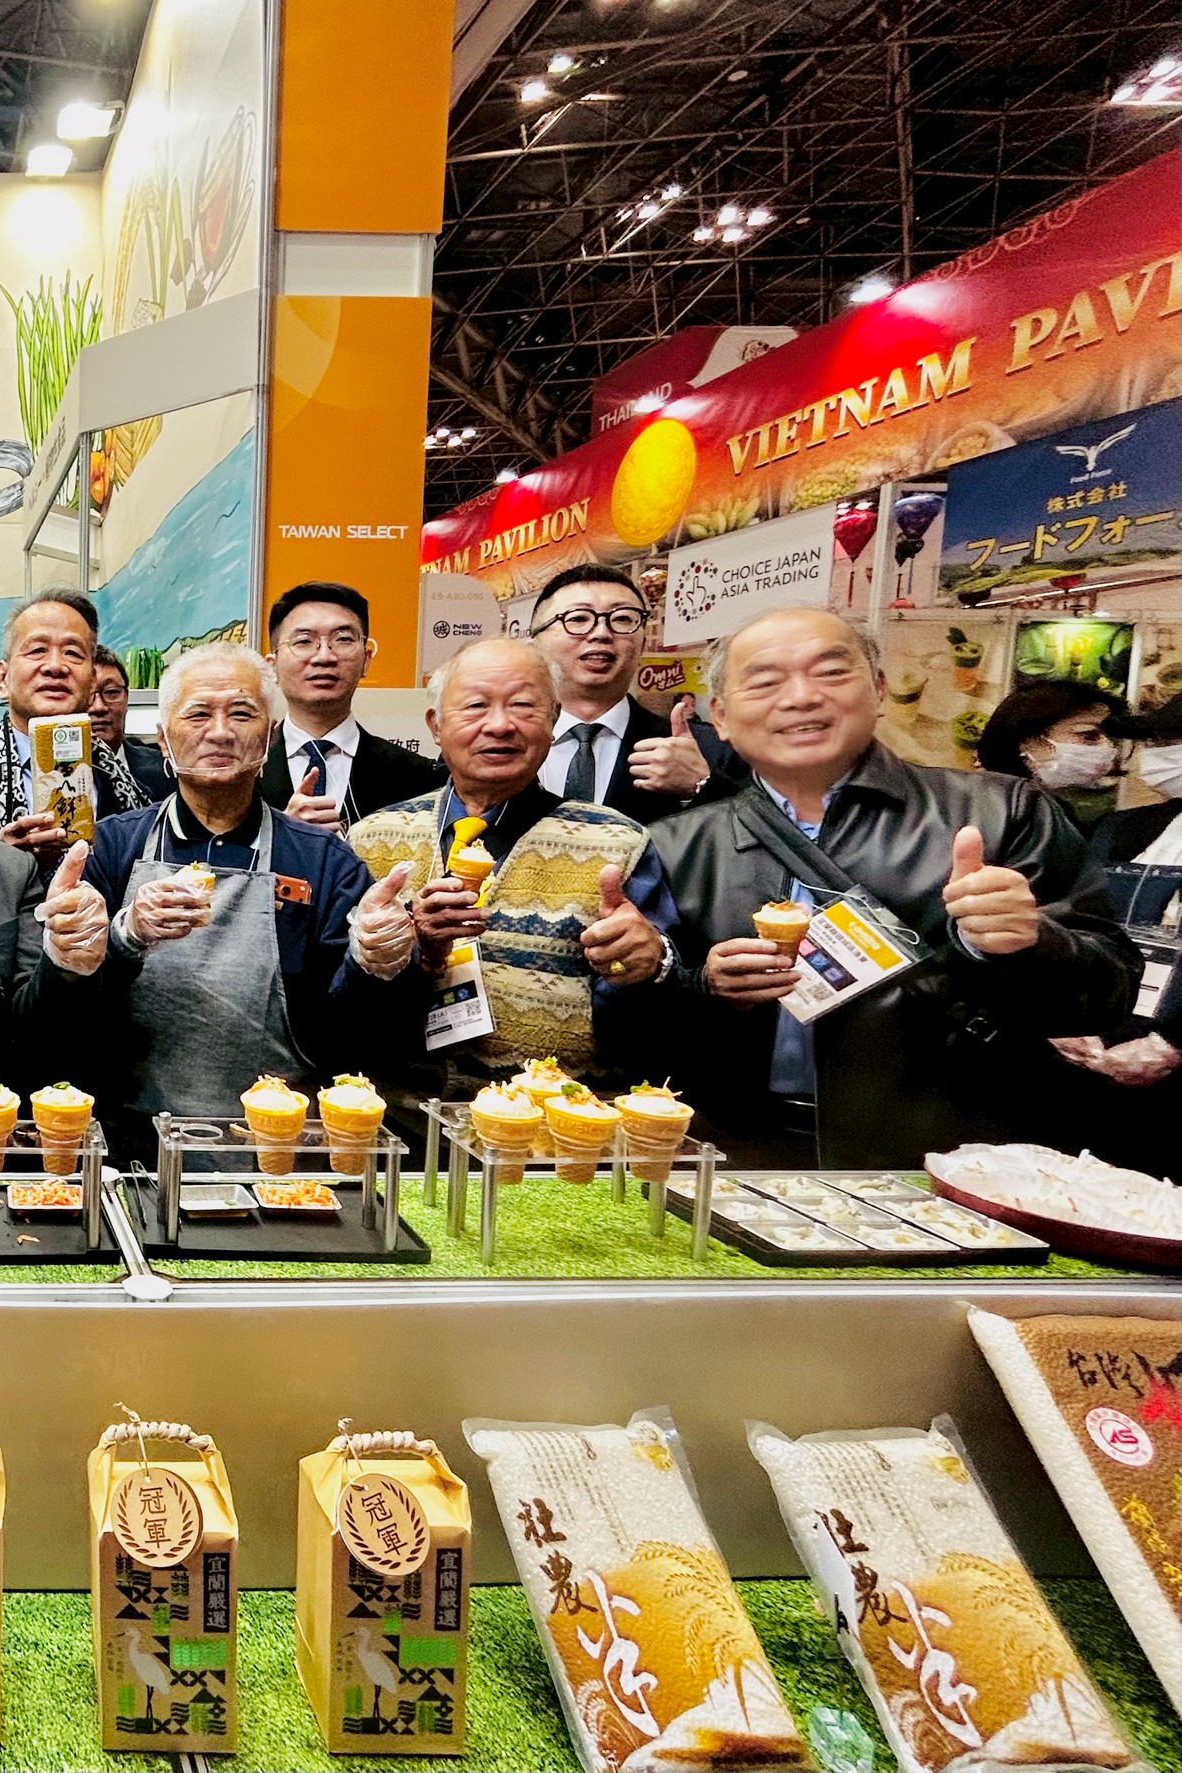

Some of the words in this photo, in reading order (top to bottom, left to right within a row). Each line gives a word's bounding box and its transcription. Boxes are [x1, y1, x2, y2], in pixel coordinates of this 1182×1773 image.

[727, 337, 976, 475] VIETNAM
[1047, 481, 1127, 513] 株式会社
[279, 525, 340, 538] TAIWAN
[347, 525, 408, 539] SELECT
[479, 498, 590, 569] PAVILION
[967, 510, 1175, 570] フードフォー
[720, 584, 749, 599] ASIA
[754, 565, 820, 591] TRADING
[721, 559, 772, 584] CHOICE
[774, 547, 821, 572] JAPAN
[640, 663, 680, 687] Omni
[139, 1487, 171, 1549] 冠軍
[361, 1492, 408, 1556] 冠軍
[207, 1555, 228, 1630] 宜蘭嚴選
[437, 1551, 459, 1628] 宜蘭嚴選
